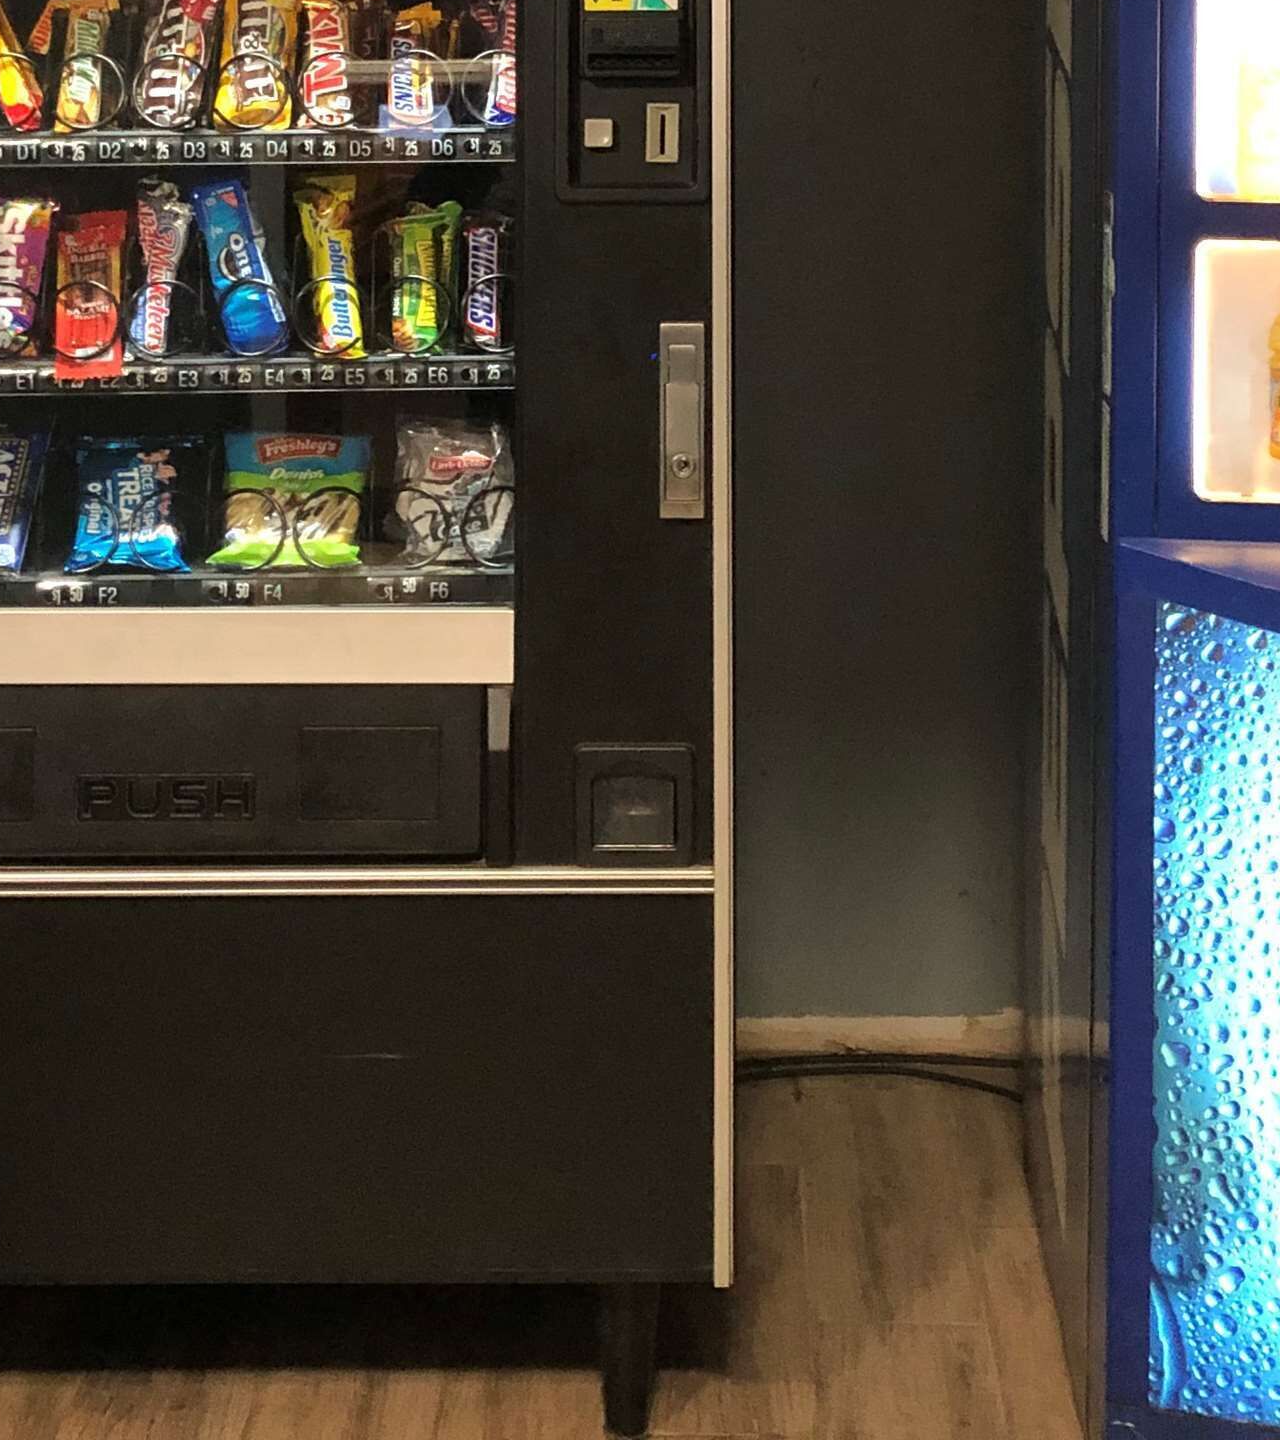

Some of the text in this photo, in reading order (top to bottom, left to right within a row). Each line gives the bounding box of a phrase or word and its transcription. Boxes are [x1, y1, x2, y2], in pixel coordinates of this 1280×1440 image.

[303, 3, 348, 108] TWIX
[15, 143, 39, 160] D1
[98, 141, 122, 160] D2
[182, 141, 207, 159] D3
[266, 140, 289, 158] D4
[349, 140, 371, 158] D5
[431, 138, 454, 157] D6
[228, 232, 255, 282] ORE
[468, 227, 498, 331] SNICKERS
[178, 370, 200, 388] E3
[264, 368, 286, 386] E4
[344, 367, 367, 385] E5
[427, 366, 449, 385] E6
[263, 437, 338, 458] Freshley's
[139, 463, 154, 494] RICE
[98, 586, 119, 604] F2
[263, 583, 283, 602] F4
[429, 581, 450, 600] F6
[76, 777, 252, 820] PUSH
